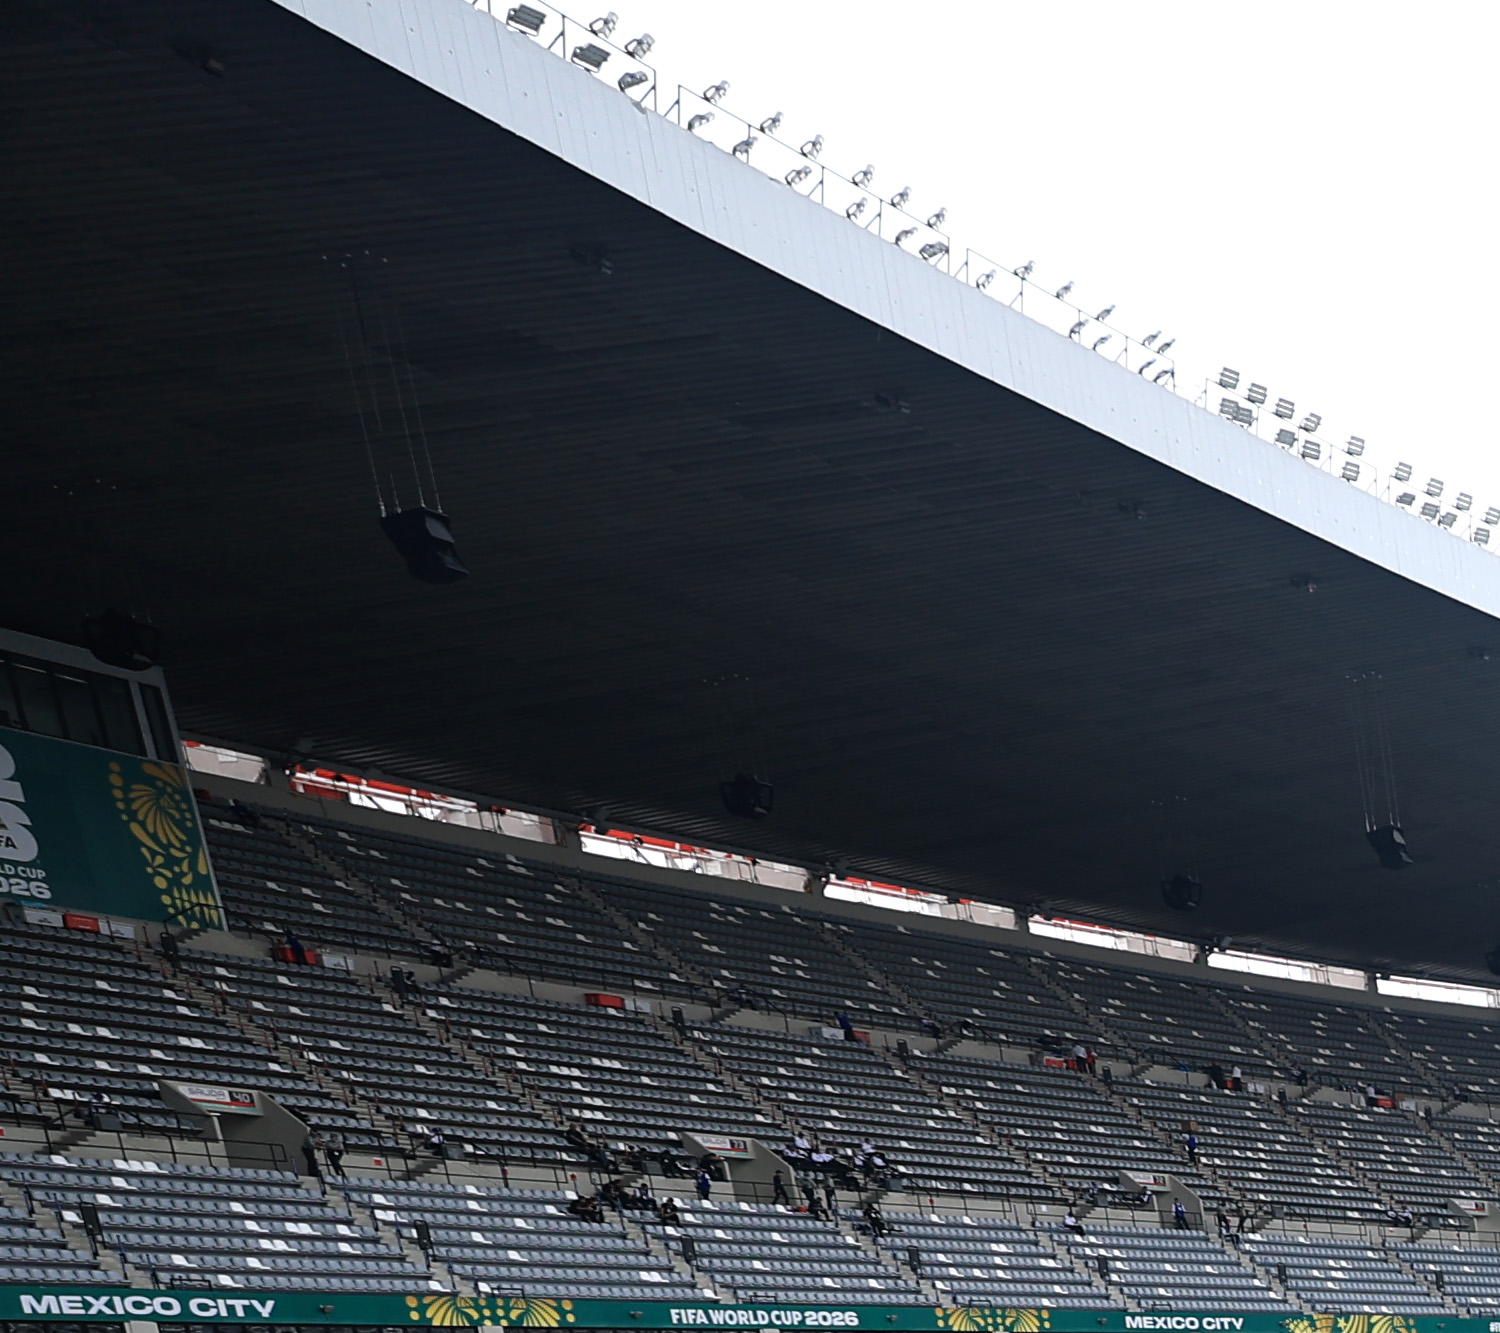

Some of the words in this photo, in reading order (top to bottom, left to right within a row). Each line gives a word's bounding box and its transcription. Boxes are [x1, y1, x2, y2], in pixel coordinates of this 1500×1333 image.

[18, 866, 46, 879] CUP
[21, 1295, 182, 1317] MEXICO
[190, 1298, 276, 1319] CITY
[671, 1308, 709, 1325] FIFA
[717, 1309, 771, 1325] WORLD
[772, 1310, 804, 1326] CUP
[805, 1310, 861, 1326] 2026
[1124, 1316, 1199, 1330] MEXICO
[1201, 1317, 1244, 1330] CITY
